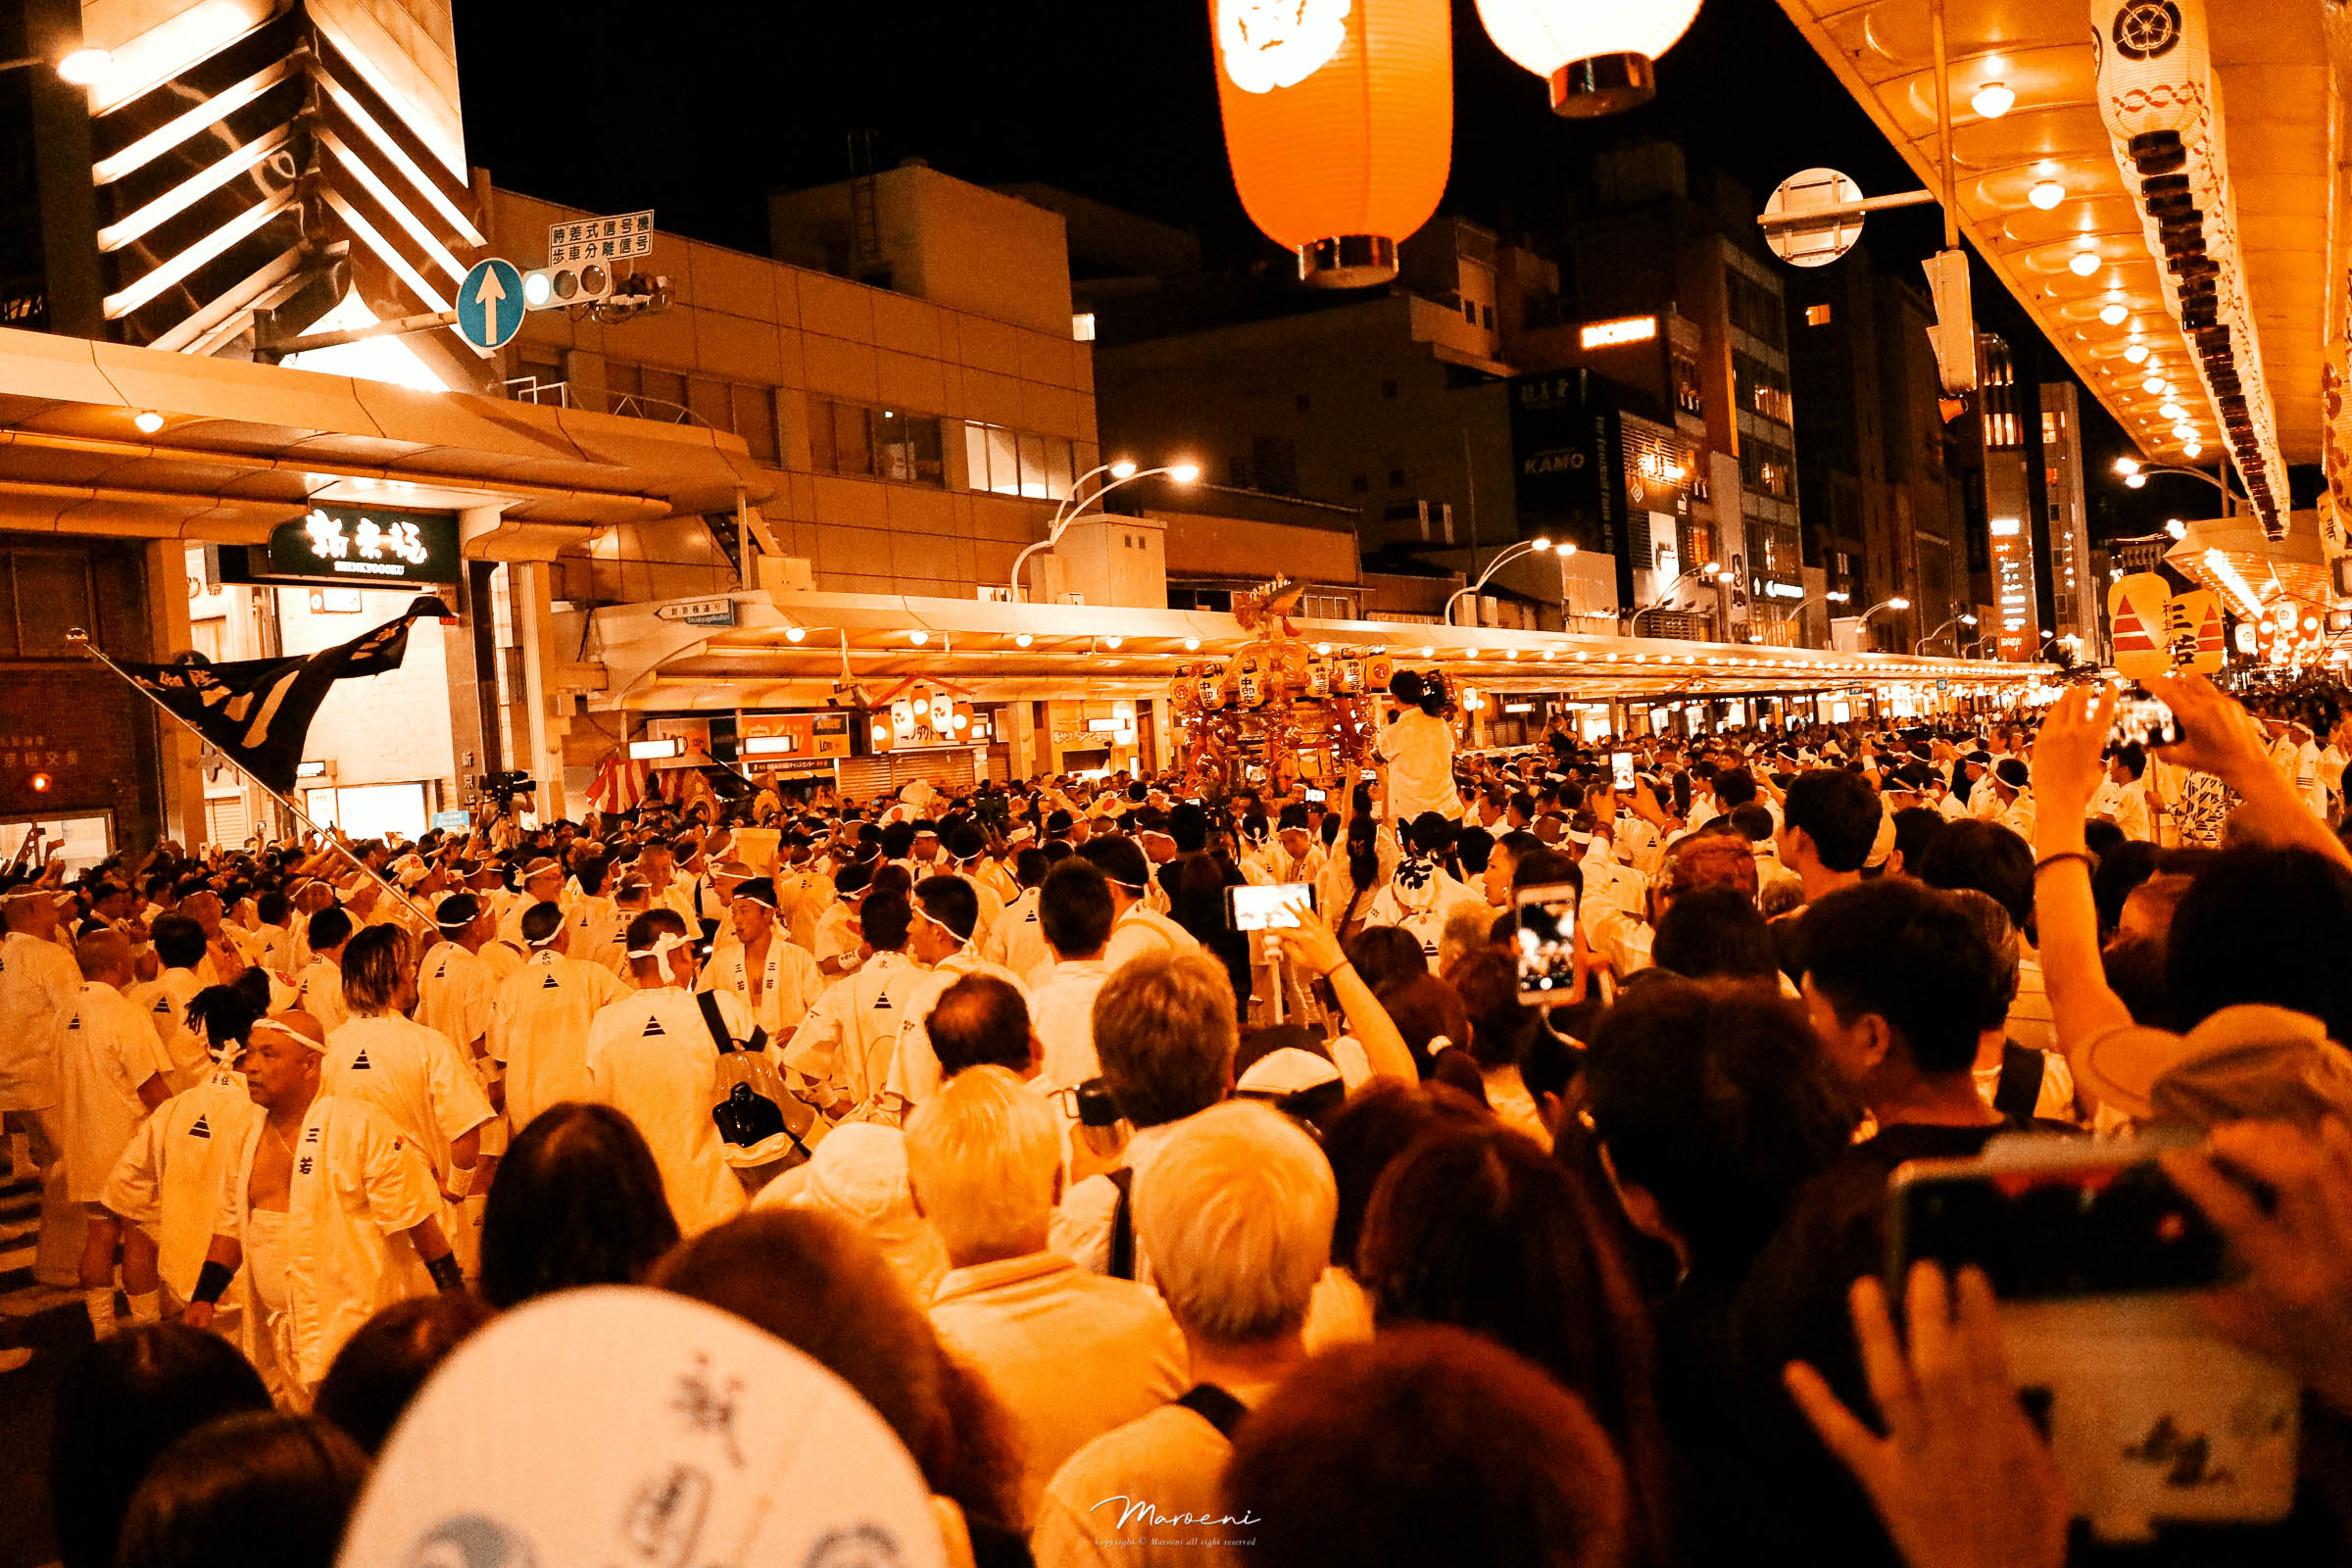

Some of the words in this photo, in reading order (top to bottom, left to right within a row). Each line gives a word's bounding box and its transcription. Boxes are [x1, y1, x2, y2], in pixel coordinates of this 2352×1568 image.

[554, 215, 649, 243] 時差式信号機
[553, 235, 648, 265] 歩車分離信号
[1524, 453, 1585, 476] KAMO
[299, 1127, 319, 1175] 三若
